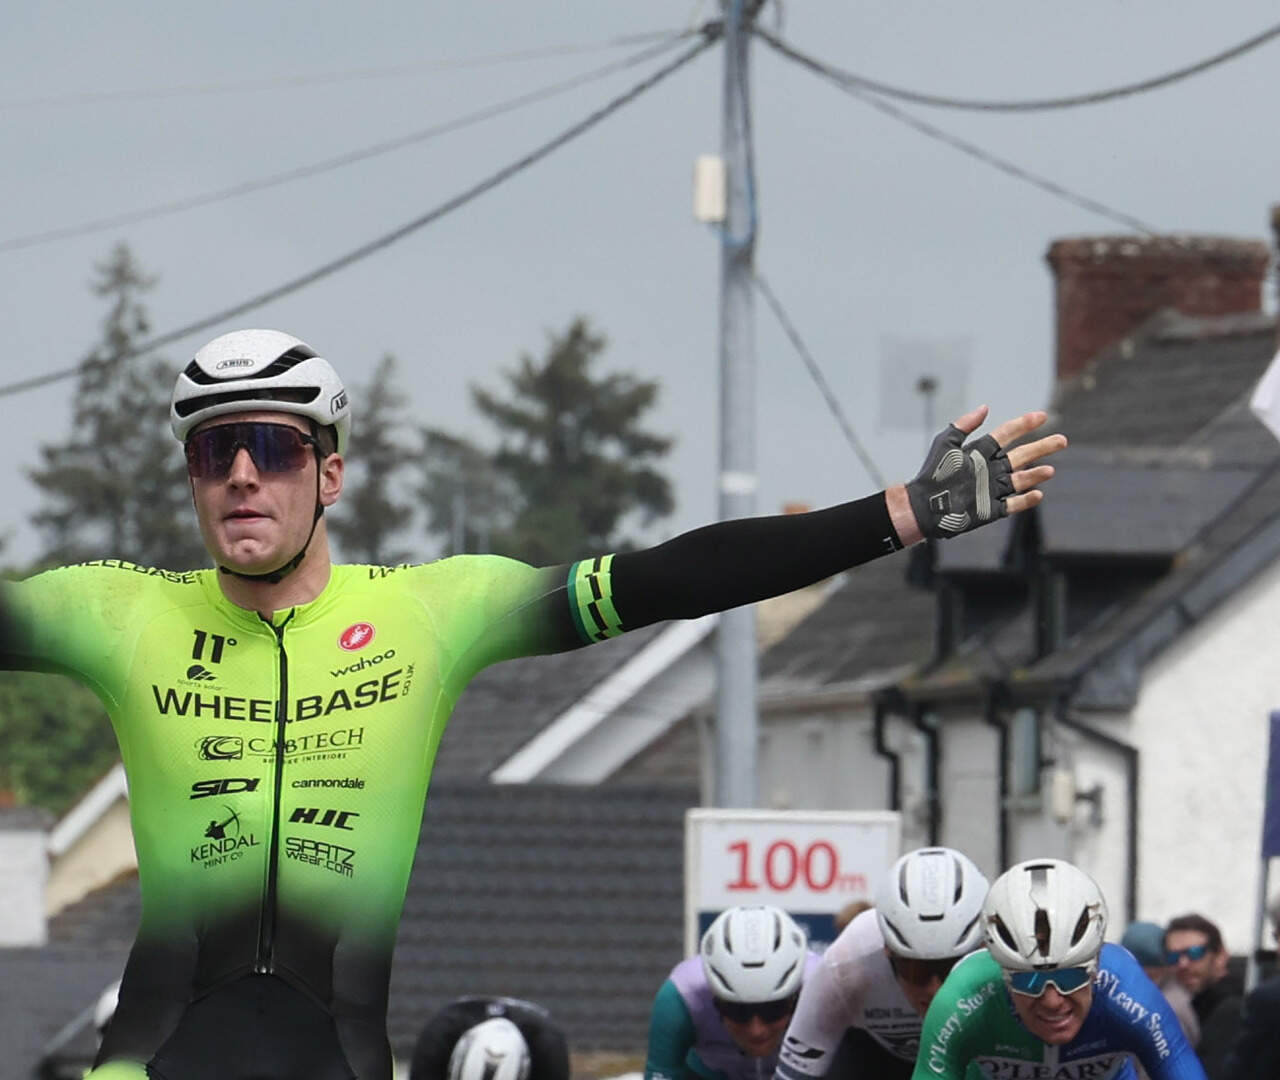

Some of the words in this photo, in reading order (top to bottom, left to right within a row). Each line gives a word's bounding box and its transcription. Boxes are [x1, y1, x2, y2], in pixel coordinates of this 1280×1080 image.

[330, 649, 396, 677] wahoo
[151, 669, 404, 723] WHEELBASE
[291, 777, 365, 790] cannondale
[288, 807, 360, 831] HJC
[190, 833, 260, 863] KENDAL
[204, 856, 227, 869] MINT
[286, 837, 356, 868] SPATZ
[928, 1010, 962, 1074] O'Leary
[1146, 1012, 1171, 1060] Stone
